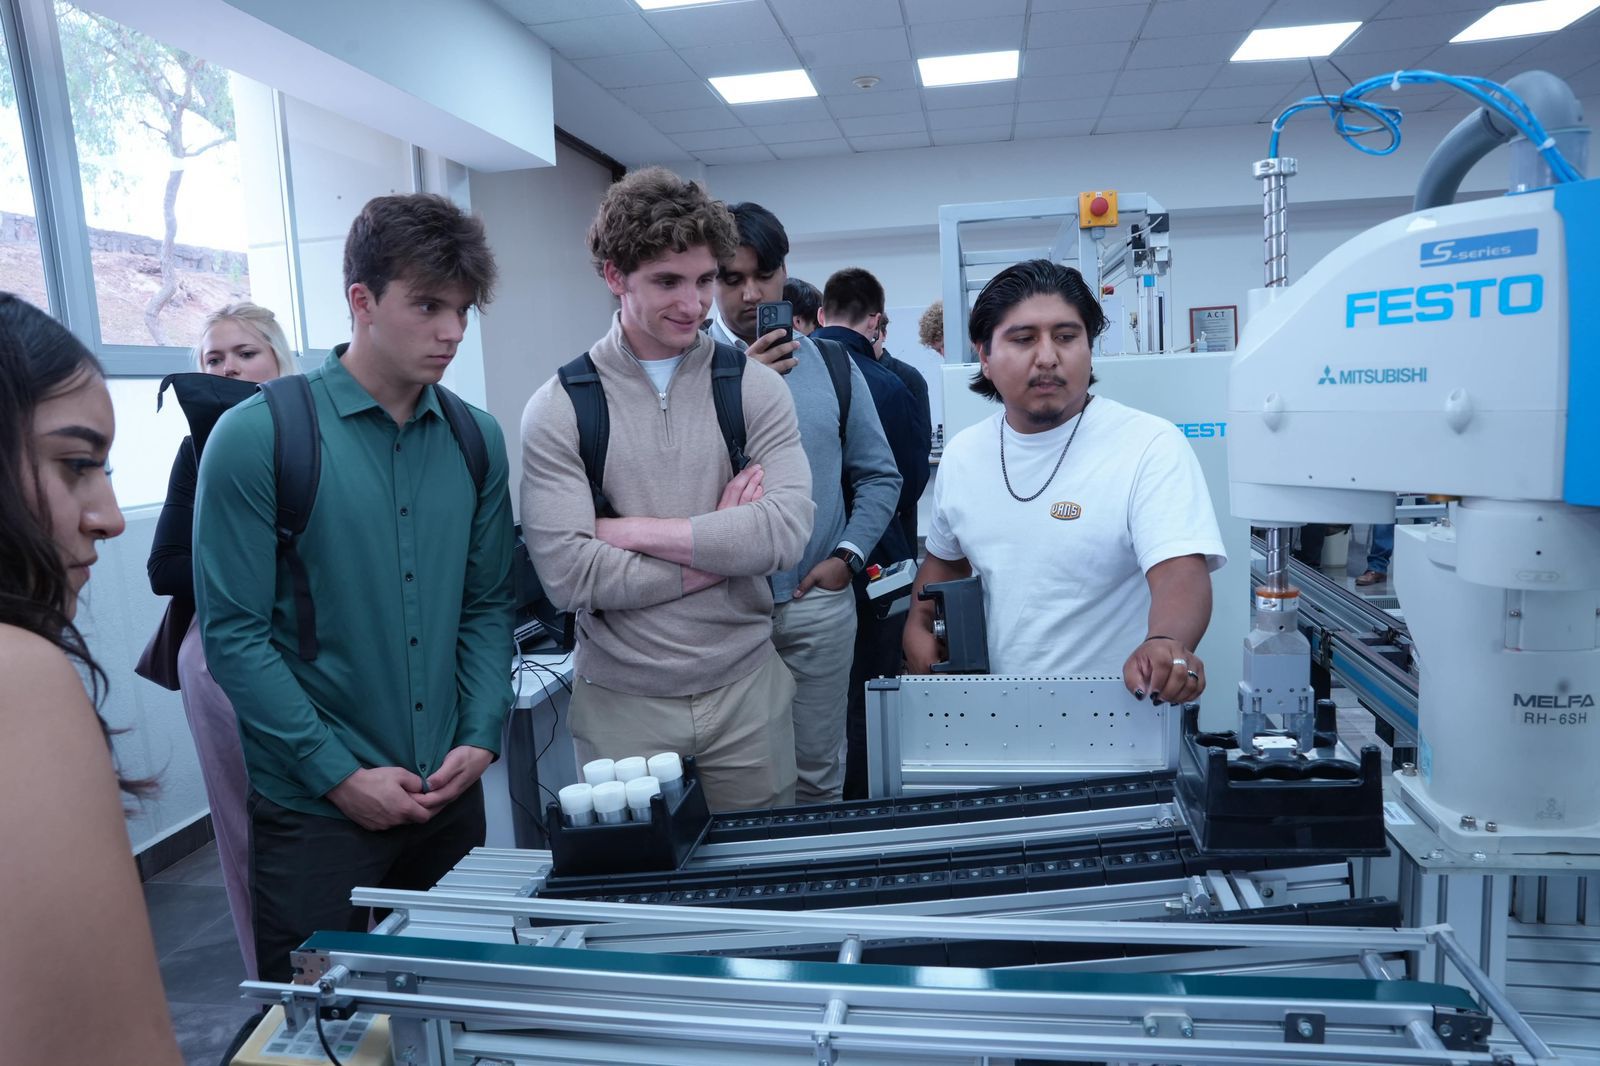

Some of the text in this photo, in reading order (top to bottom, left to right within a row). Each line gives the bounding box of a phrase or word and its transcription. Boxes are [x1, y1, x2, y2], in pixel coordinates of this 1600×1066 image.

[1432, 241, 1512, 263] S-series
[1345, 273, 1544, 329] FESTO
[1339, 367, 1428, 385] MITSUBISHI
[1174, 422, 1227, 438] EST
[1051, 503, 1078, 516] VANS
[1513, 692, 1595, 709] MELFA
[1524, 711, 1587, 725] RH-6SH
